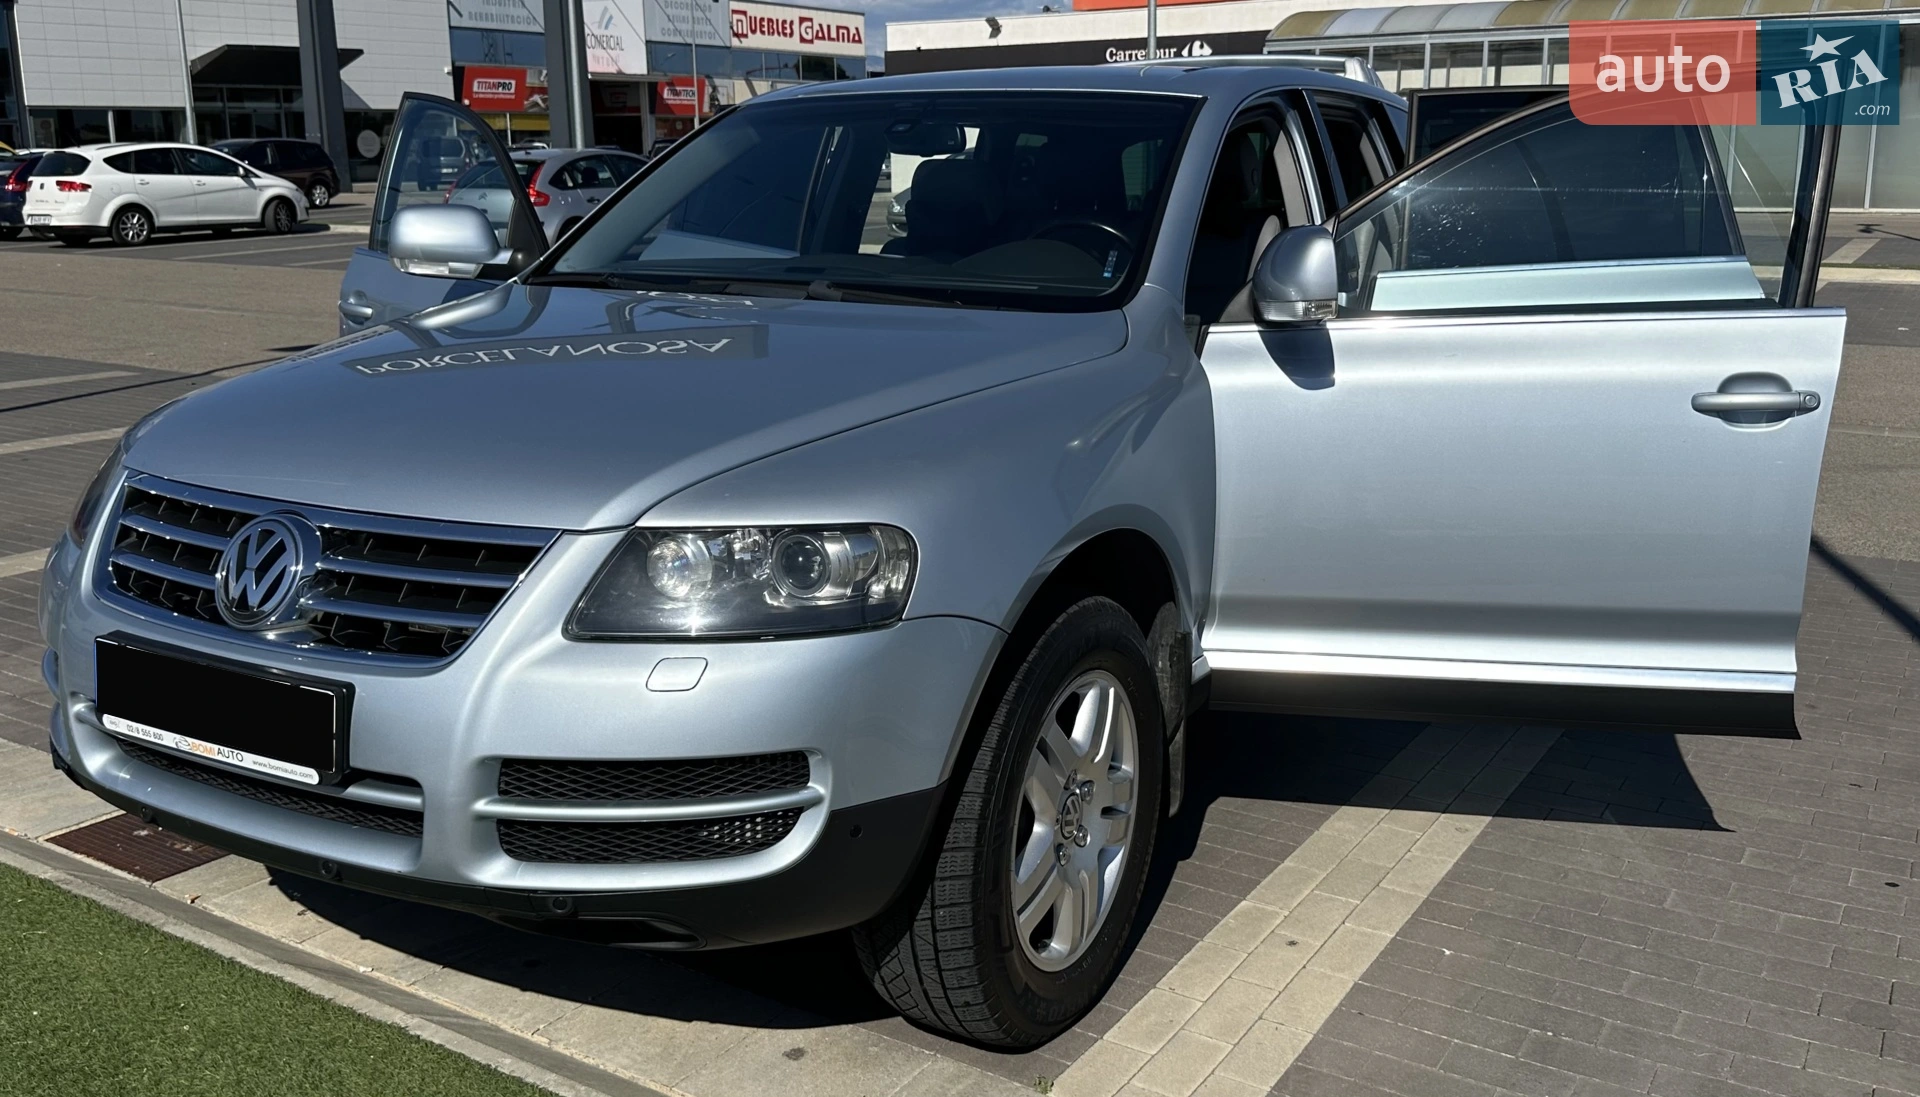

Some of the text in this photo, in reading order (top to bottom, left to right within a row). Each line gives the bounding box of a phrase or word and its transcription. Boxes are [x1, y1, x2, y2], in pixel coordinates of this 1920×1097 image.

[664, 1, 712, 13] DECORCÓN
[731, 9, 862, 44] MUEBLES GALMA
[1105, 46, 1177, 62] Carreur
[476, 80, 513, 92] TITANPRO
[217, 747, 244, 762] AUTO
